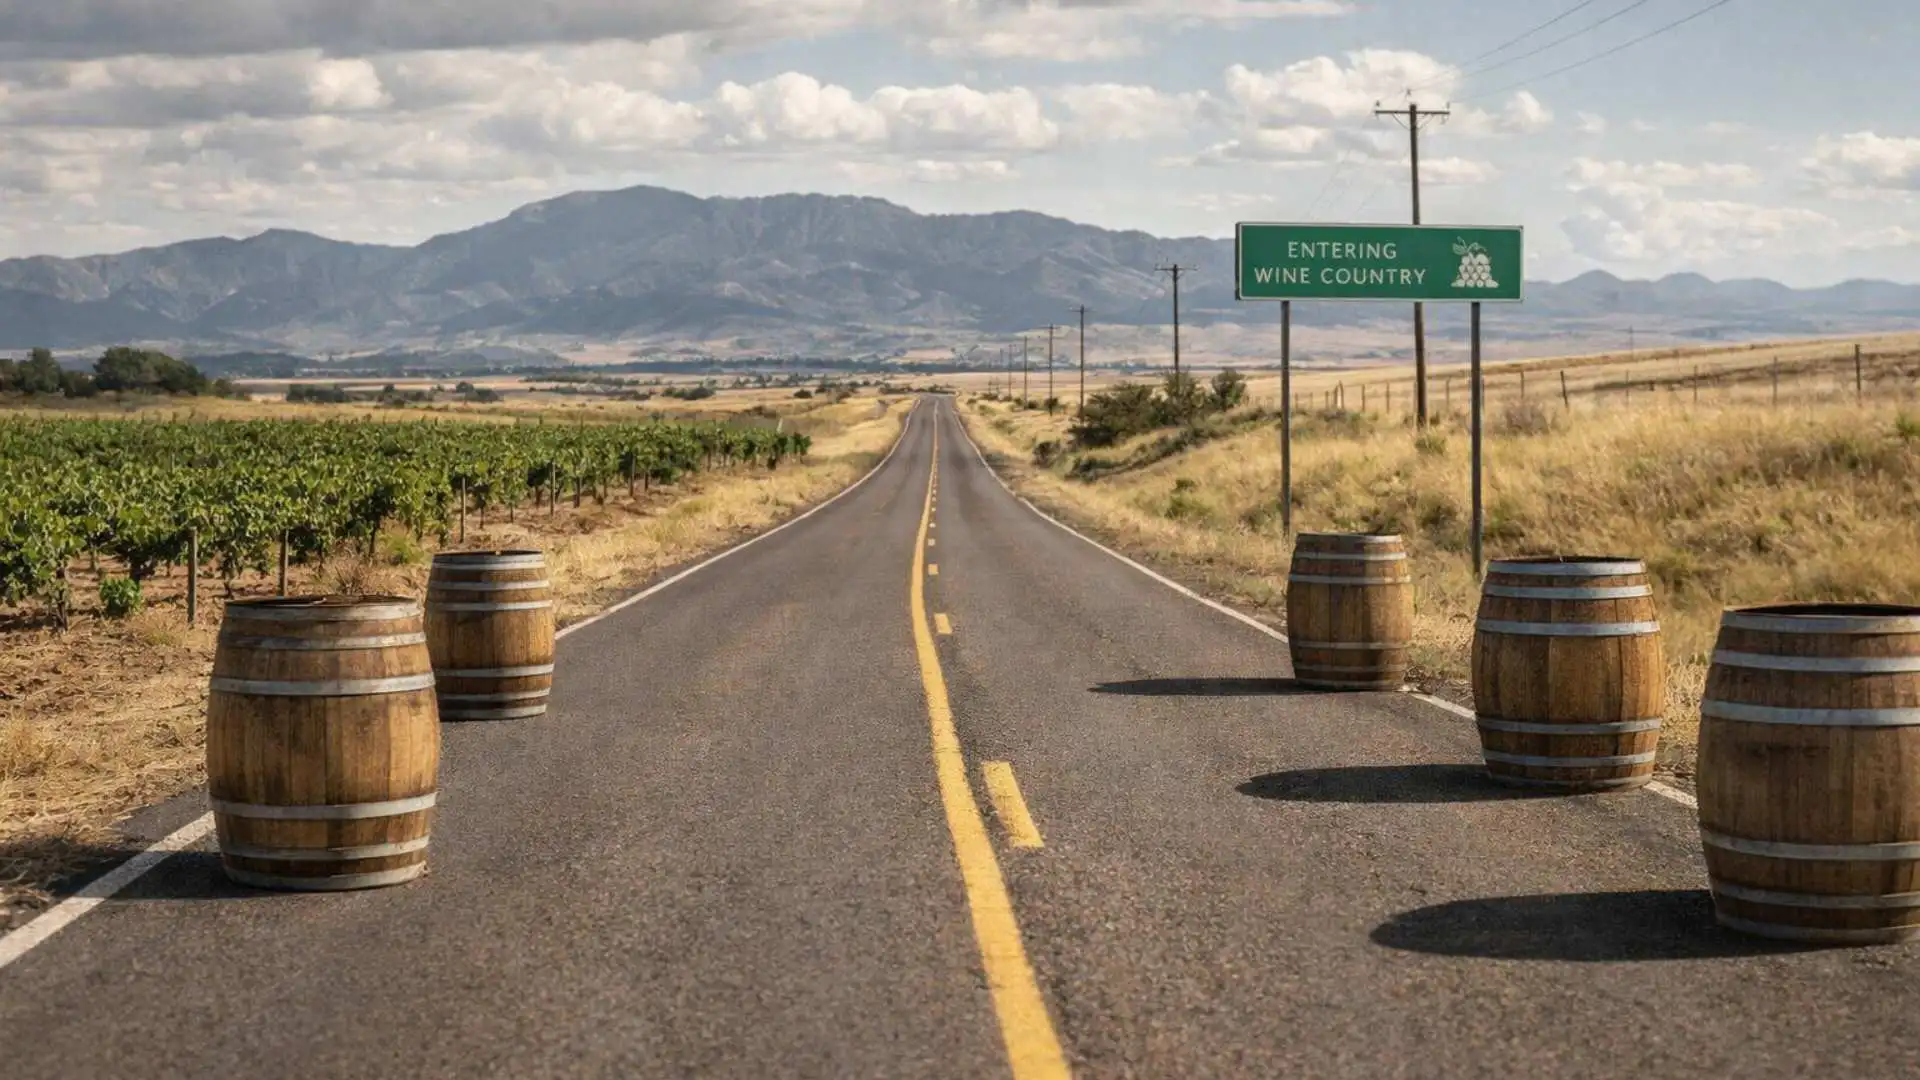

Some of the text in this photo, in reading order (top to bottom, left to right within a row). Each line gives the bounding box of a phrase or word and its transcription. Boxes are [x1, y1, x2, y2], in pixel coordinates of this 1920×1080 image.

[1288, 241, 1397, 259] ENTERING
[1254, 267, 1426, 285] WINE COUNTRY
